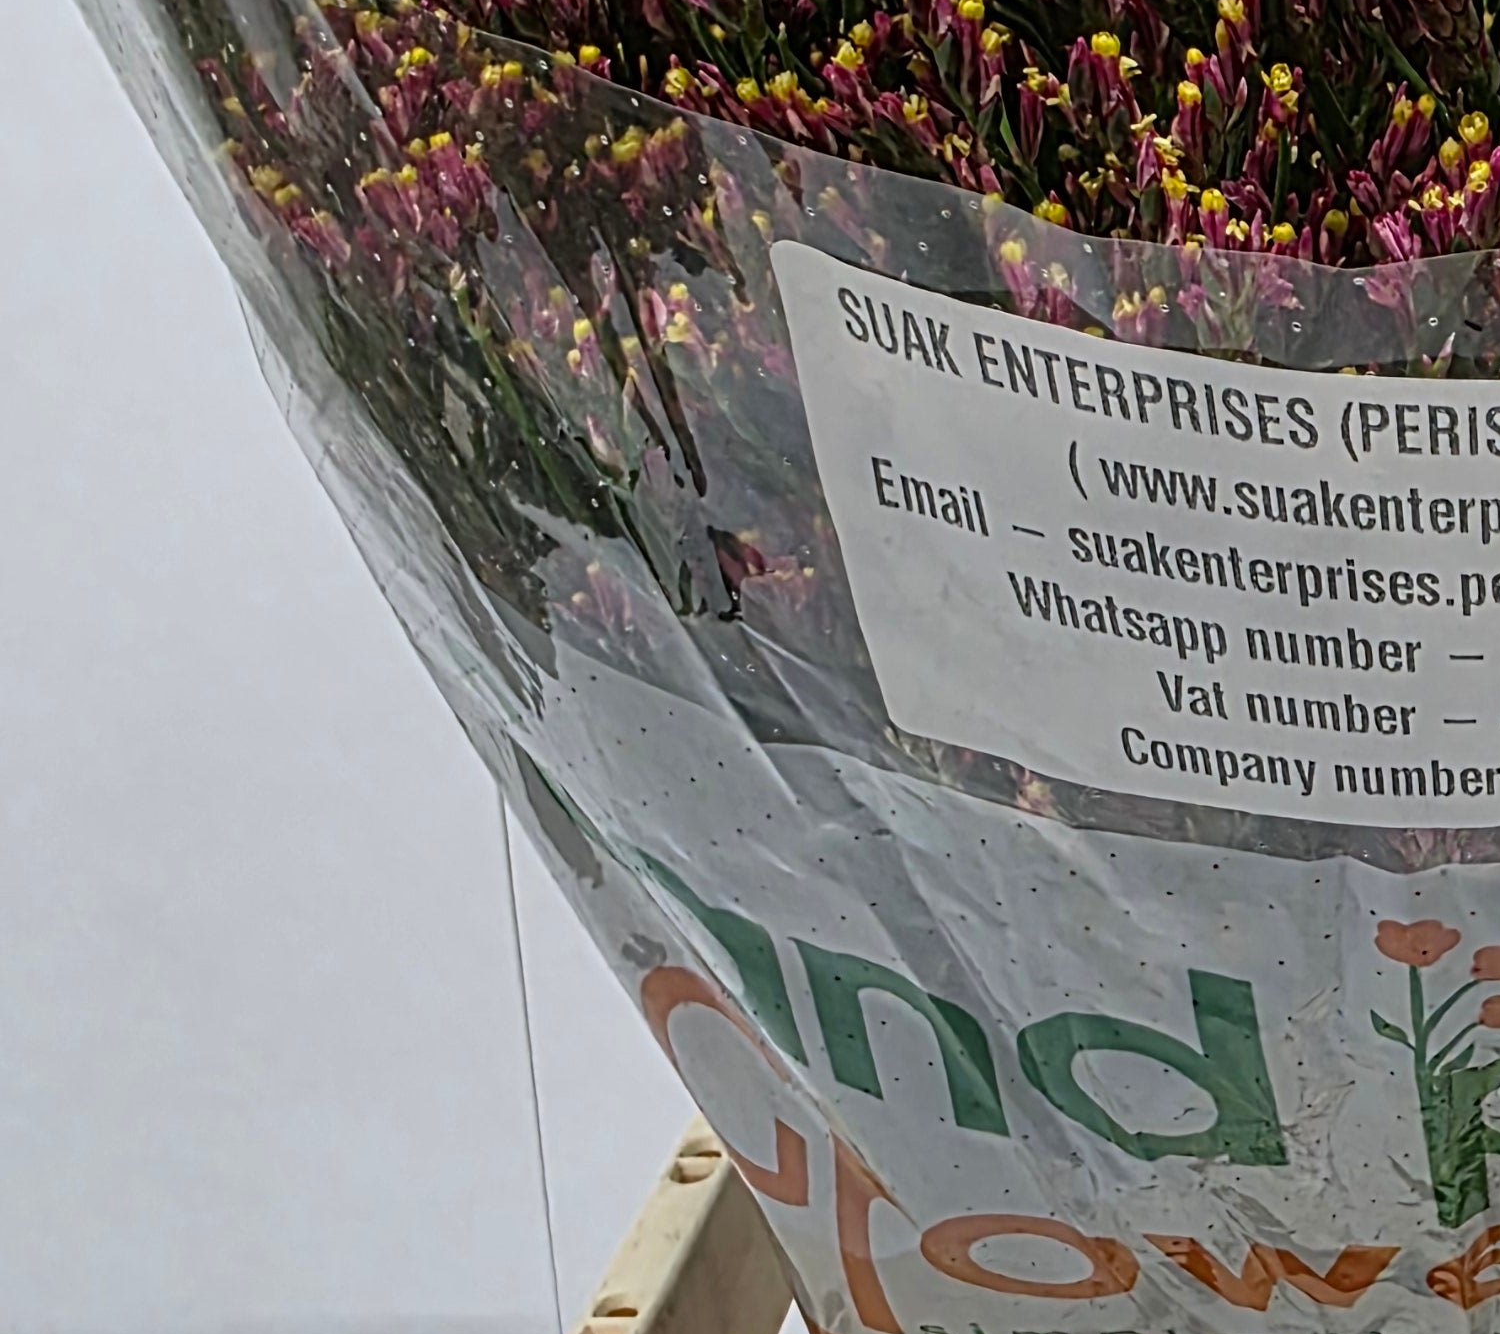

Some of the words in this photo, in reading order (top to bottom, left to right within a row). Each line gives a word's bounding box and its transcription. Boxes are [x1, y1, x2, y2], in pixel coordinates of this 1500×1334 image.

[838, 288, 962, 377] SUAK
[973, 332, 1318, 449] ENTERPRISES
[871, 456, 989, 537] Email
[1007, 571, 1227, 664] Whatsapp
[1246, 628, 1421, 672] number
[1156, 671, 1228, 720] Vat
[1246, 693, 1416, 735] number
[1121, 727, 1315, 796] Company
[1335, 760, 1500, 796] number
